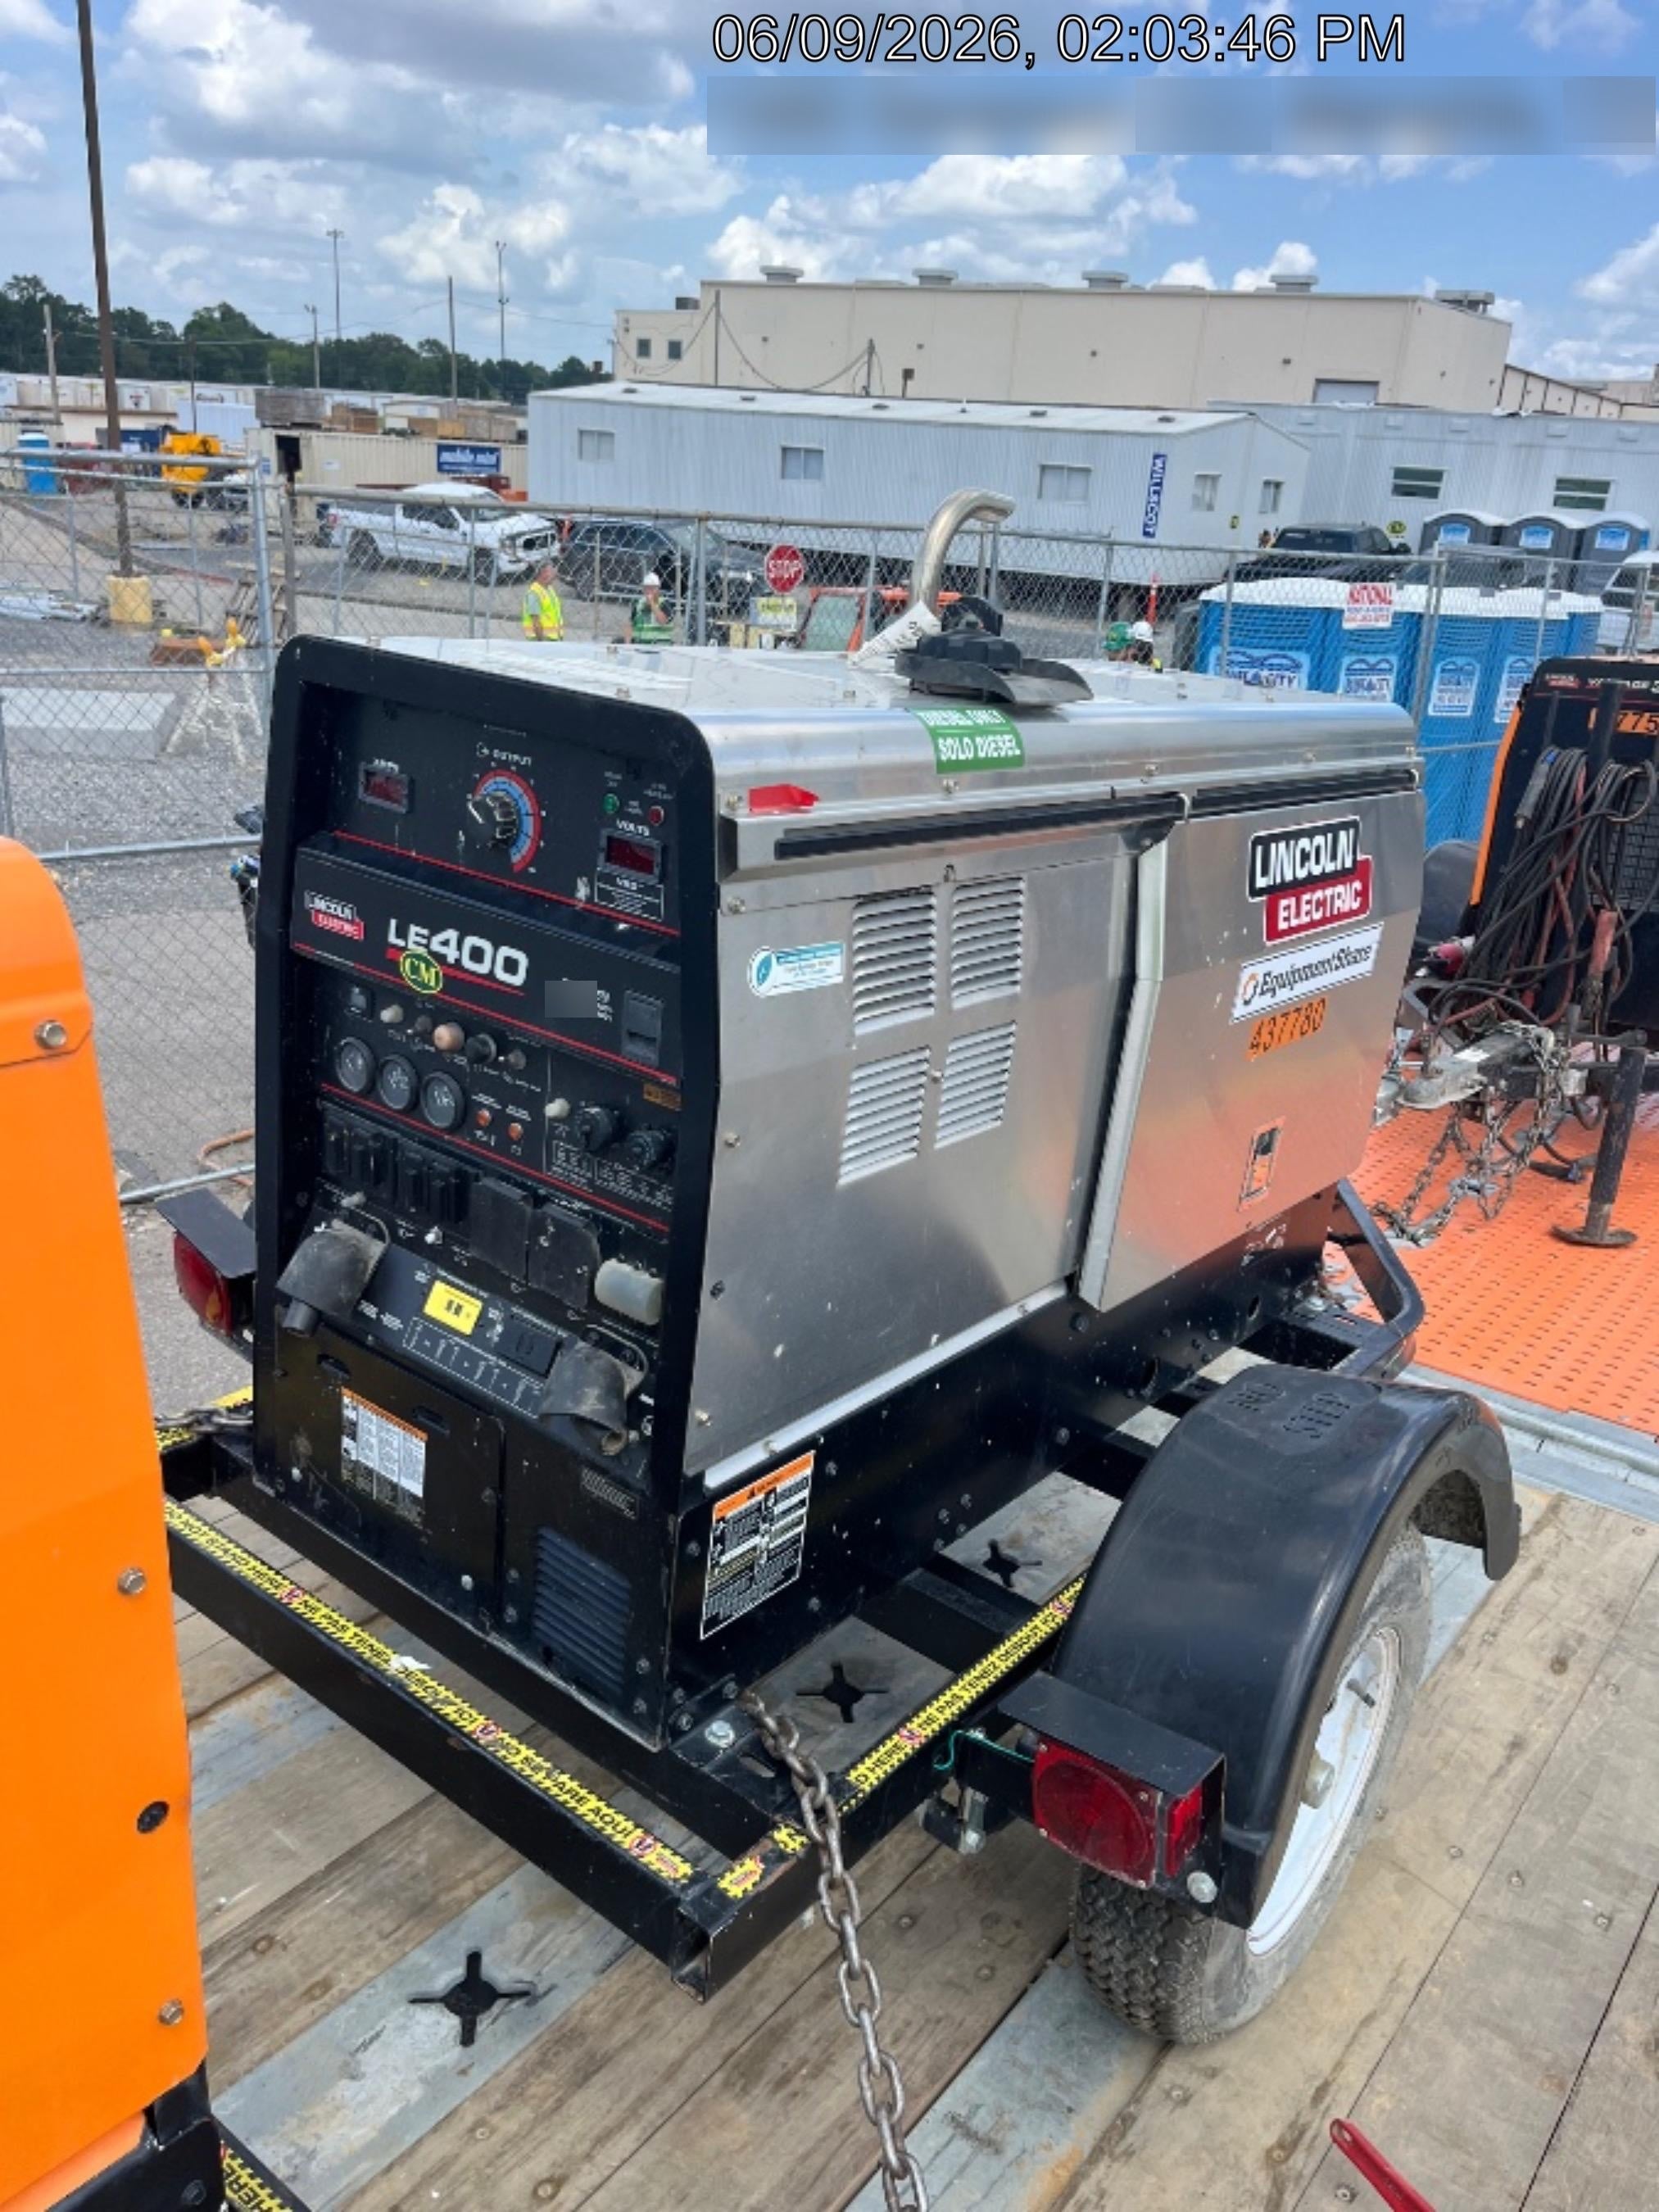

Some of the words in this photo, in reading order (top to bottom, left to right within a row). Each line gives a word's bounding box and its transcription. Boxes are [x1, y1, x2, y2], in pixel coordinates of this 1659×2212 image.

[1145, 456, 1166, 535] WILLSCOT
[768, 560, 801, 579] STOP
[917, 709, 974, 727] DIESEL
[938, 737, 974, 763] SOLO
[975, 733, 1021, 759] DIESEL
[616, 818, 650, 837] VOLTS
[1255, 829, 1356, 889] LINCOLN
[1277, 879, 1363, 931] ELECTRIC
[405, 957, 438, 988] CM
[1258, 944, 1373, 999] EquipmentShare
[1249, 996, 1326, 1054] 437780
[319, 1612, 349, 1634] PAS
[589, 1805, 632, 1839] AQUI
[868, 1741, 909, 1774] HERE
[936, 1691, 966, 1716] PAS
[963, 1660, 999, 1693] TENEZ
[999, 1625, 1045, 1662] DEBOUT
